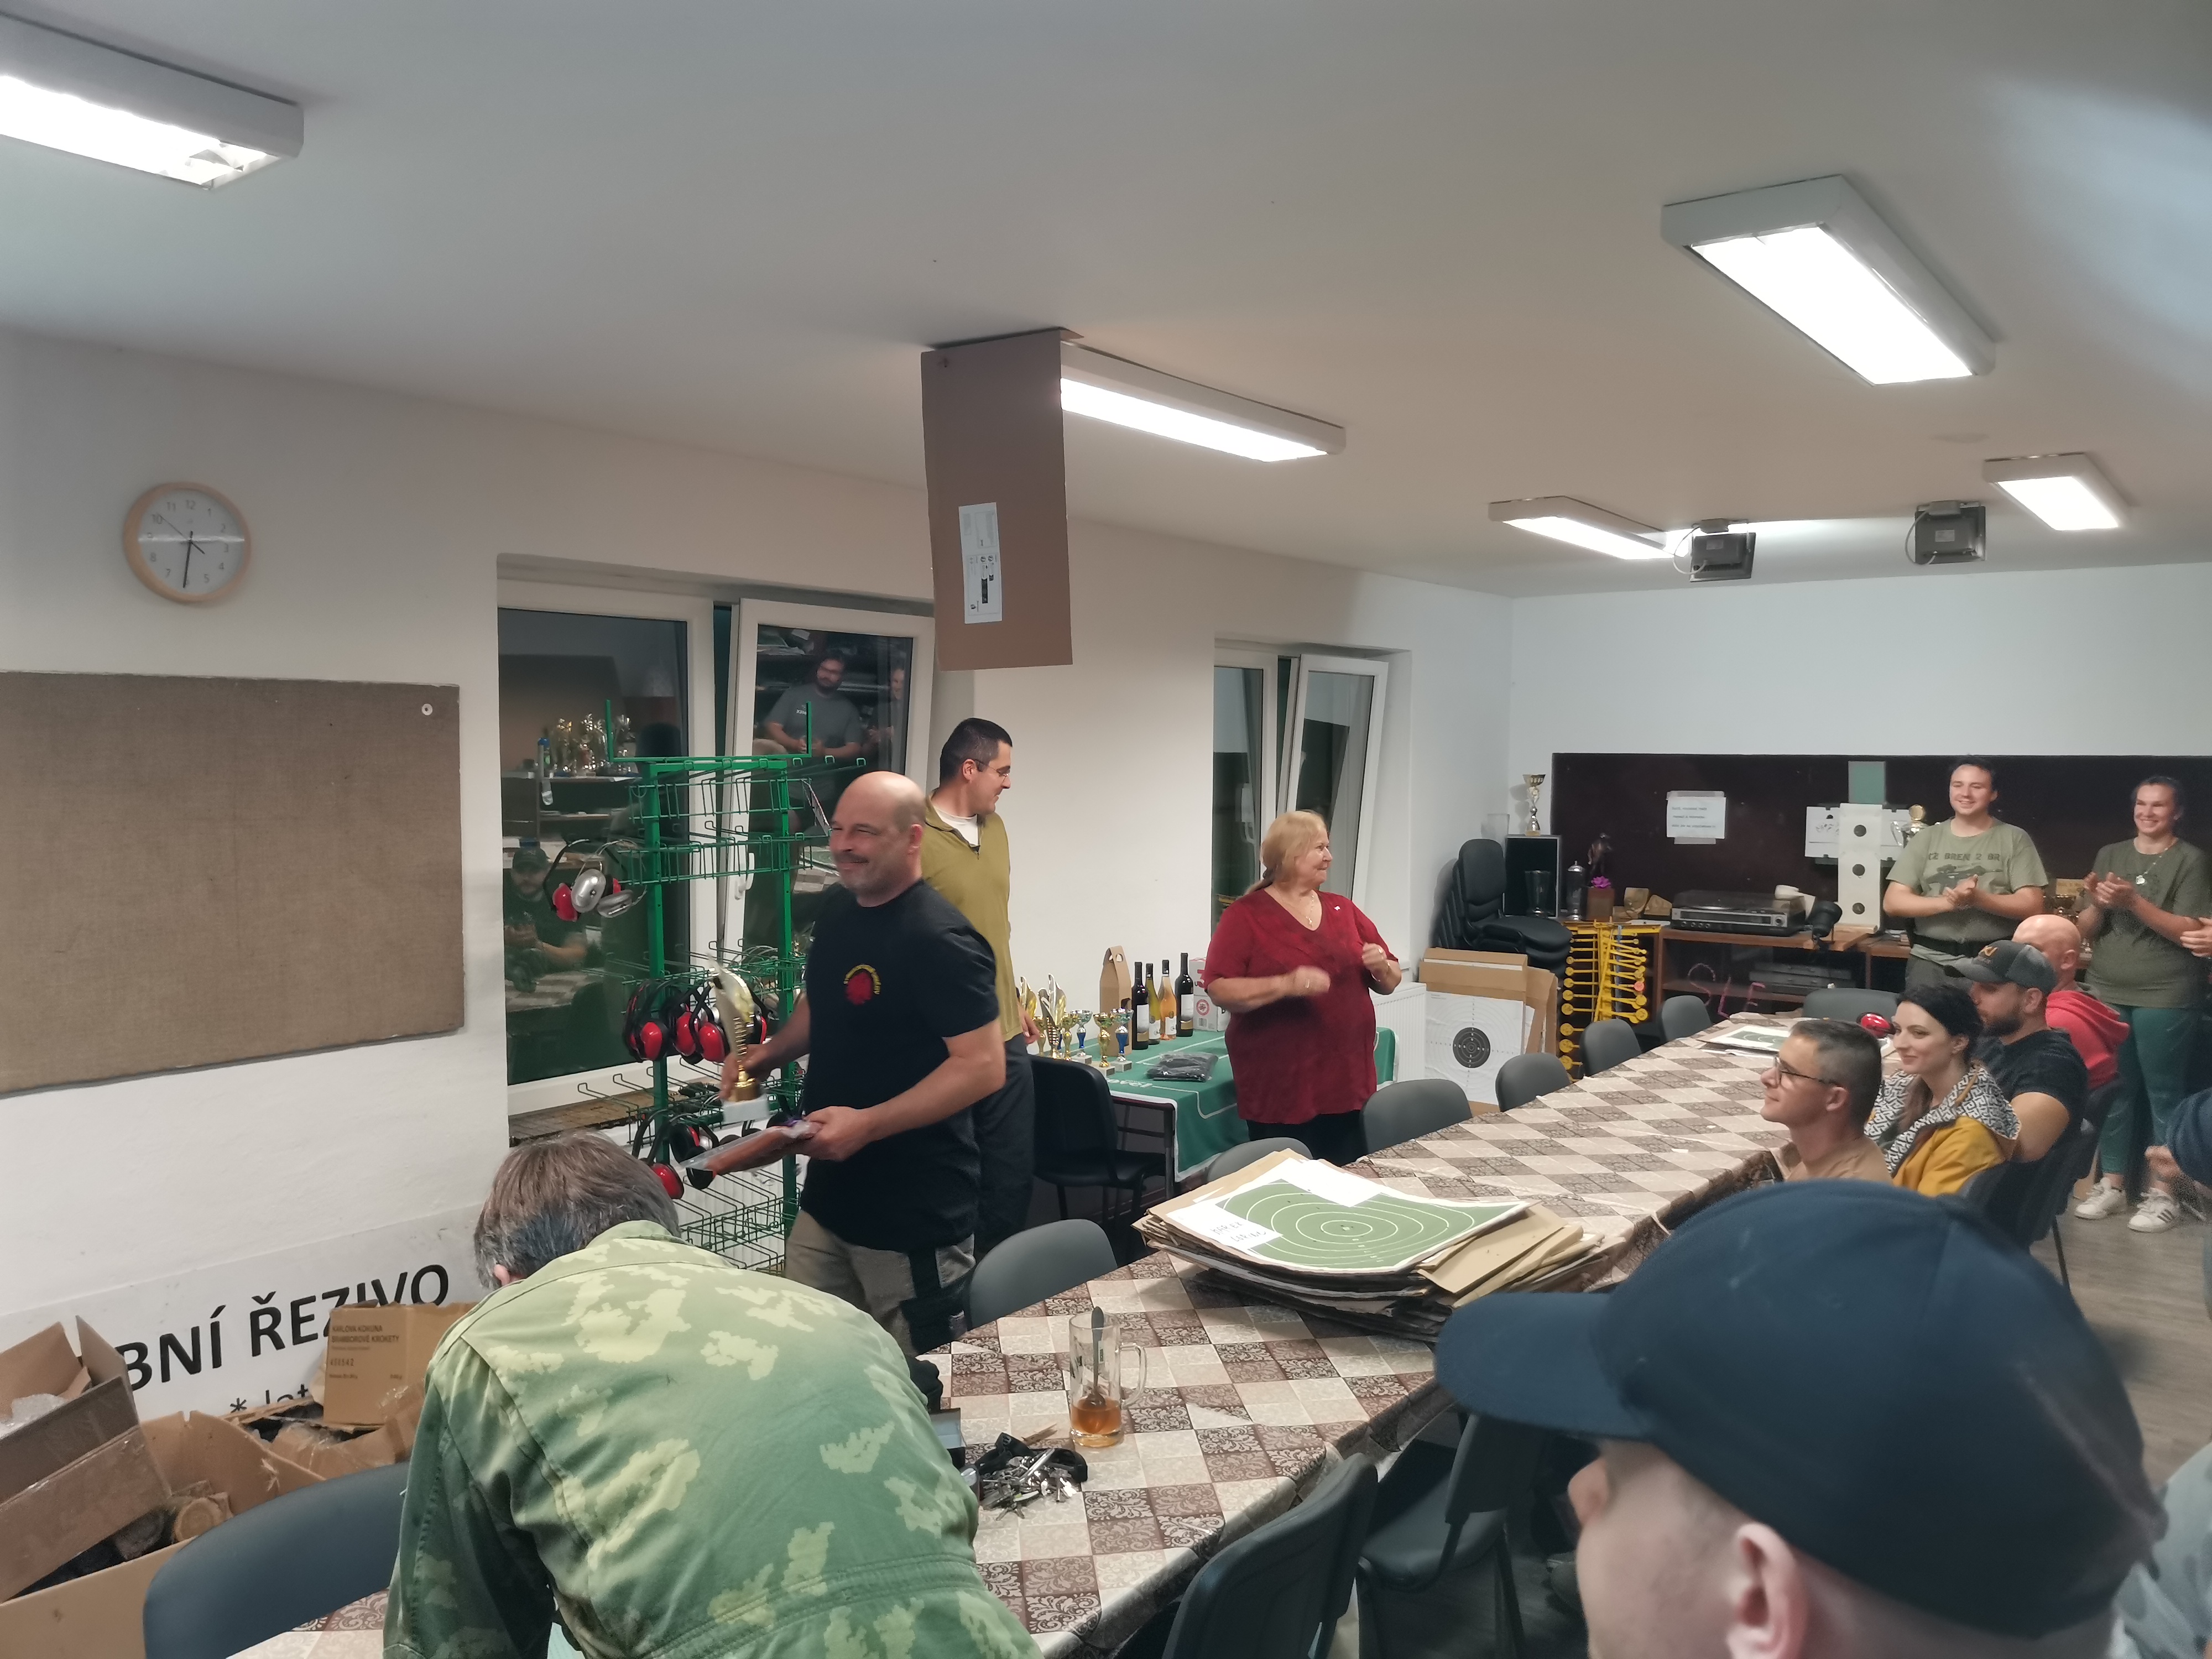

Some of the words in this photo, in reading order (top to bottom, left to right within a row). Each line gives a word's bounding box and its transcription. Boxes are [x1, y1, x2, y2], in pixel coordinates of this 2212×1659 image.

[166, 502, 176, 512] 11
[186, 499, 196, 510] 12
[152, 514, 163, 524] 10
[150, 552, 156, 562] 8
[166, 568, 171, 577] 7
[204, 573, 210, 583] 5
